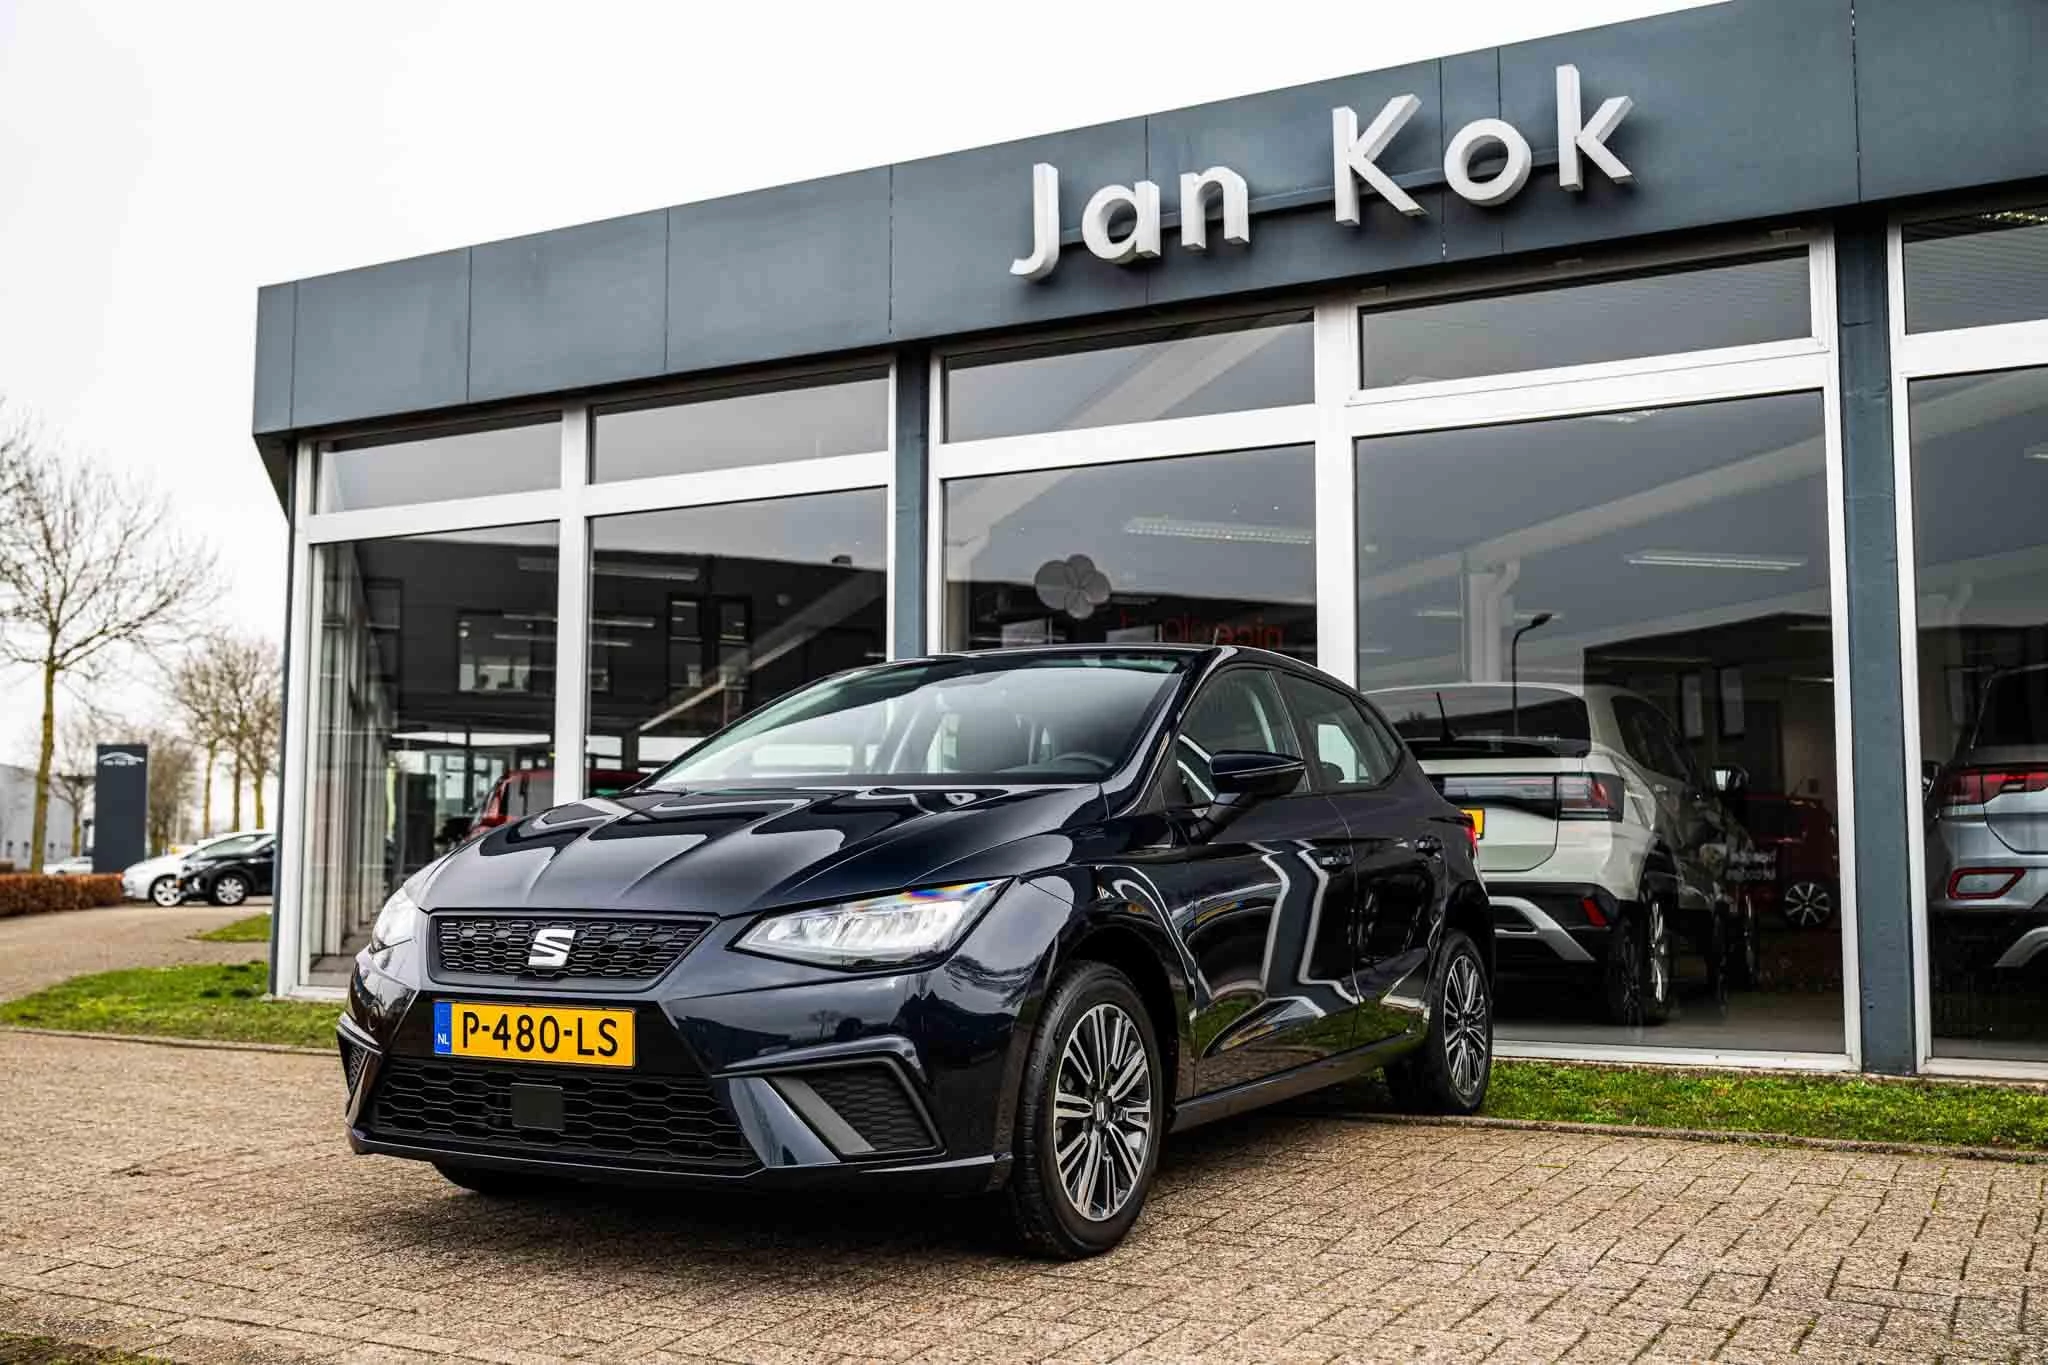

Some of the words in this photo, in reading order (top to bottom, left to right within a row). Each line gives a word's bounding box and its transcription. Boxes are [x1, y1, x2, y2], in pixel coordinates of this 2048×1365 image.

[1010, 163, 1249, 281] Jan
[1331, 63, 1636, 227] Kok
[437, 1033, 449, 1046] NL
[462, 1011, 619, 1057] P-480-LS
